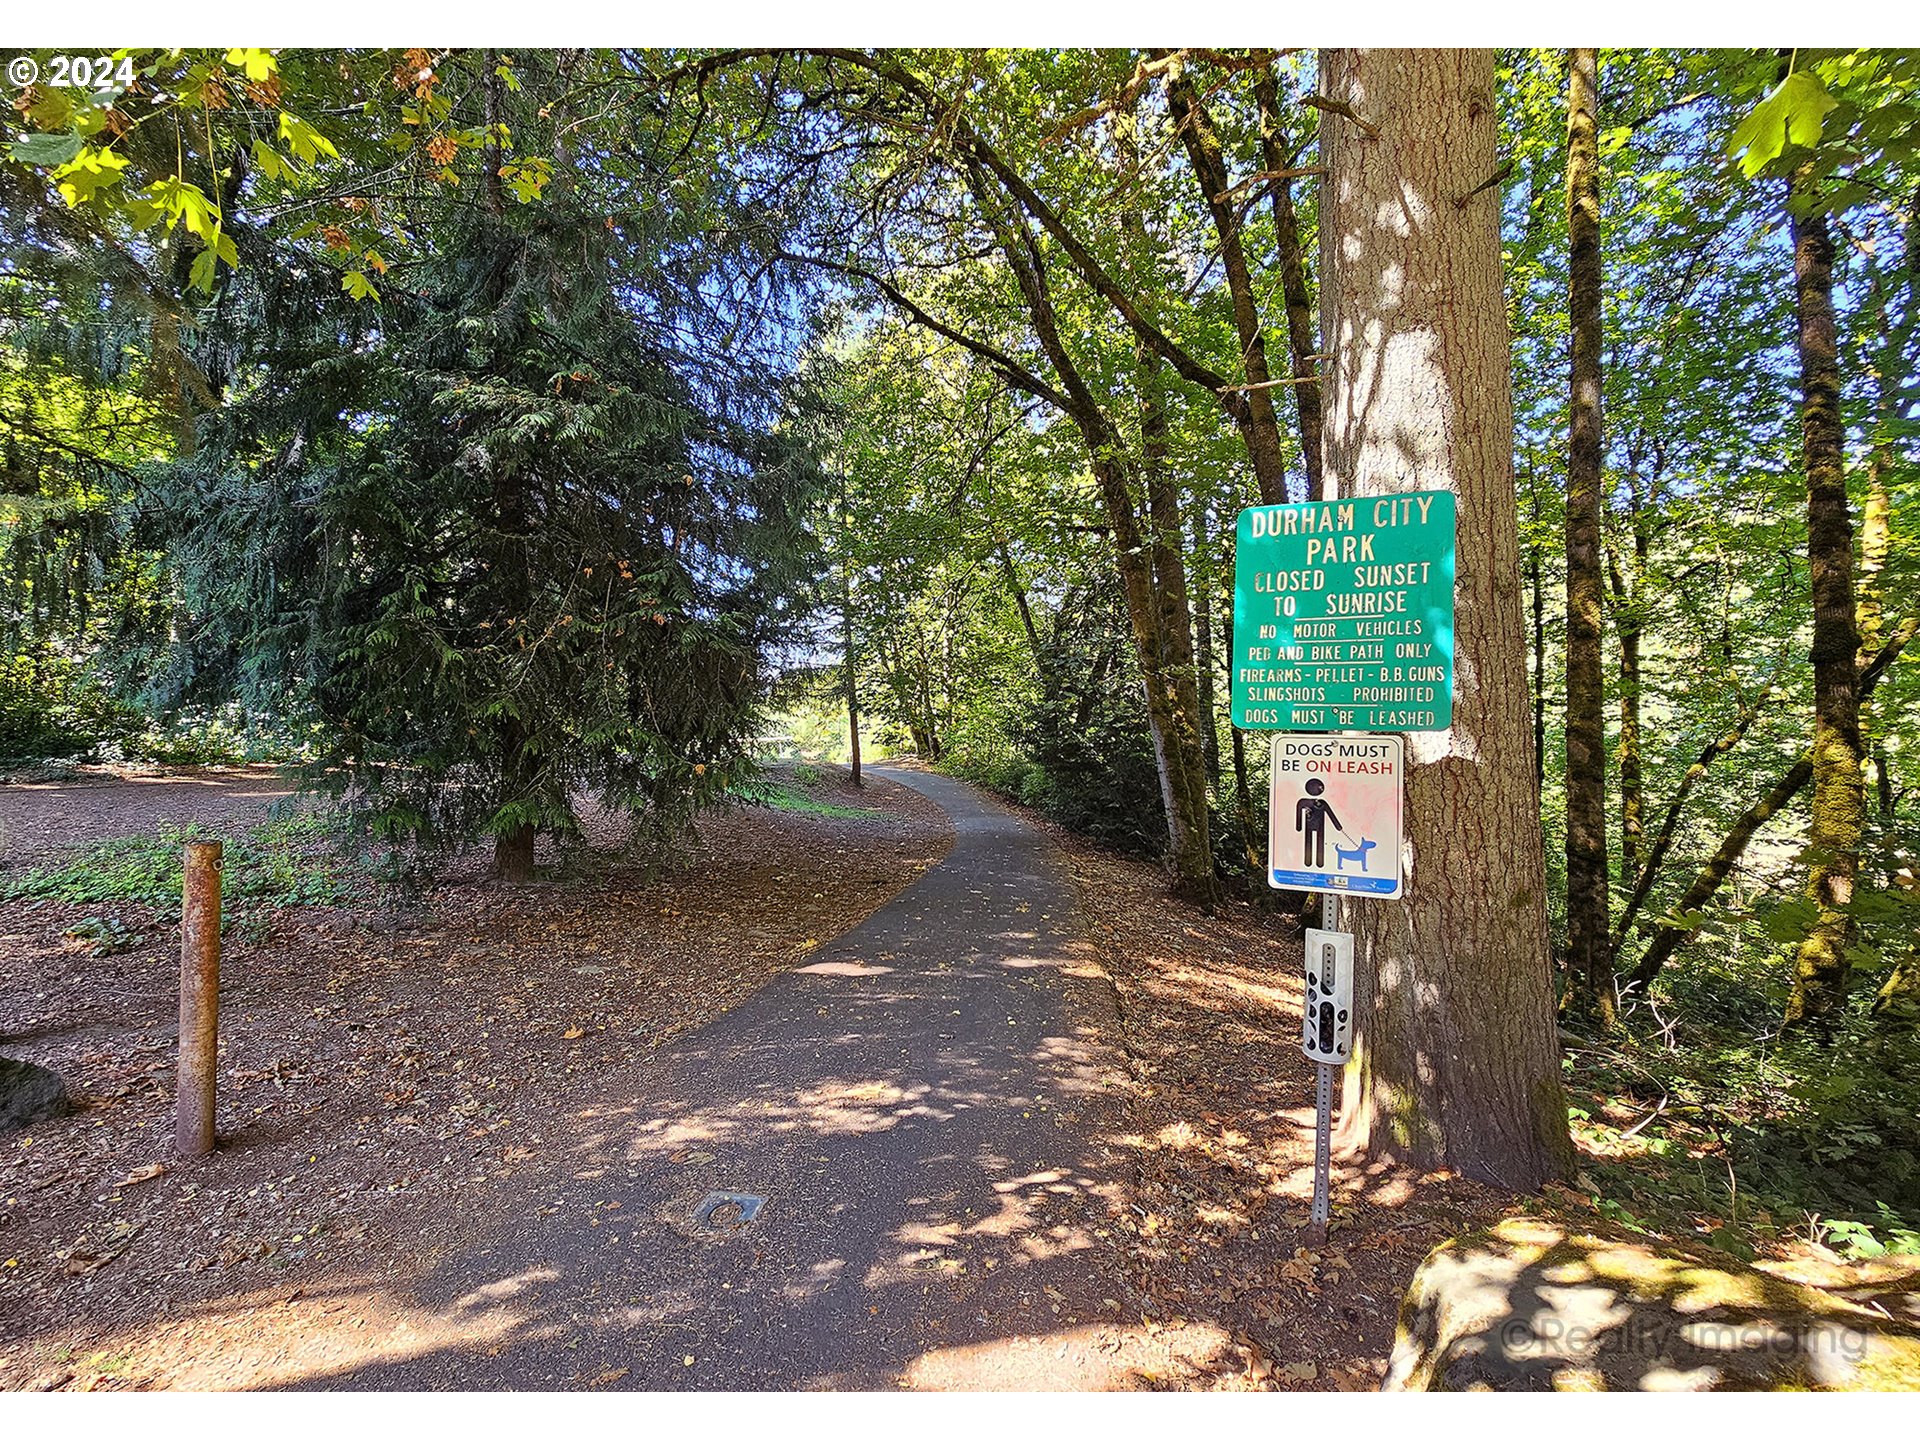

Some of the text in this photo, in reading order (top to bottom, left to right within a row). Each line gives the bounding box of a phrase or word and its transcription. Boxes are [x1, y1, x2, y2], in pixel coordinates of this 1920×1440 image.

[1252, 495, 1434, 538] DURHAM CITY
[1306, 534, 1376, 566] PARK
[1254, 562, 1431, 593] CLOSED SUNSET
[1273, 591, 1408, 617] TO SUNRISE
[1259, 619, 1422, 639] NO MOTOR VEHICLES
[1249, 643, 1432, 661] PED AND BIKE PATH ONLY
[1240, 668, 1302, 683] FIREARMS
[1316, 668, 1364, 683] PELLET
[1408, 666, 1445, 682] GUNS
[1248, 687, 1434, 702] SLINGSHOTS PROHIBITED
[1245, 709, 1435, 726] DOGS MUST BE LEASHED
[1286, 743, 1389, 757] DOGS MUST
[1281, 760, 1393, 775] BE ON LEASH
